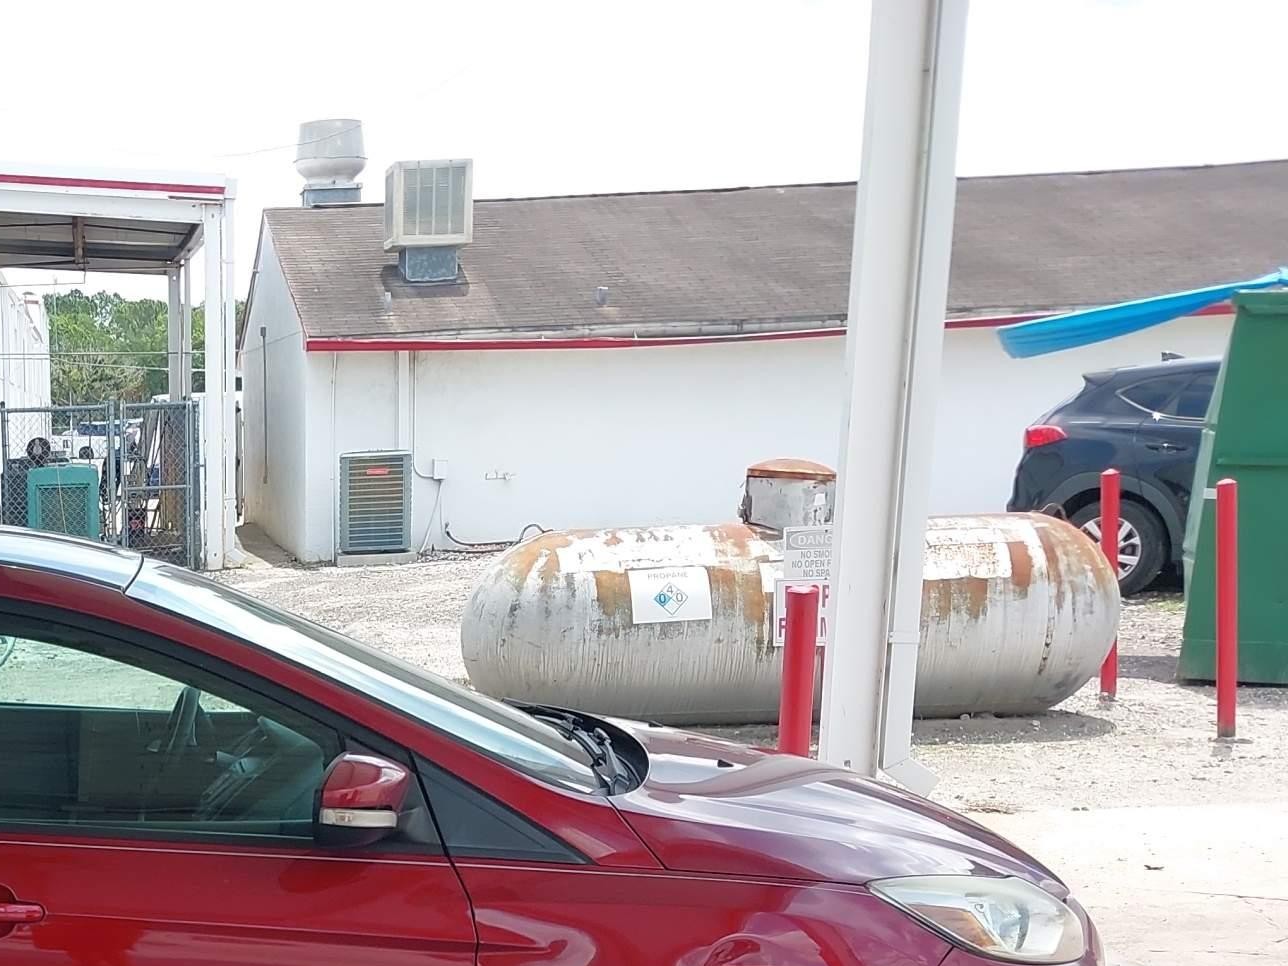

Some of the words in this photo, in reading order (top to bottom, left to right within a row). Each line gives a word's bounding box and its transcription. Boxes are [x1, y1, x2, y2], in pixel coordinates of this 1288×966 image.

[801, 551, 811, 559] NO
[791, 560, 802, 568] NO
[804, 559, 825, 568] OPEN
[647, 571, 688, 580] PROPANE
[803, 569, 813, 577] NO
[667, 585, 674, 594] 4
[659, 593, 666, 603] 0
[676, 592, 683, 602] 0
